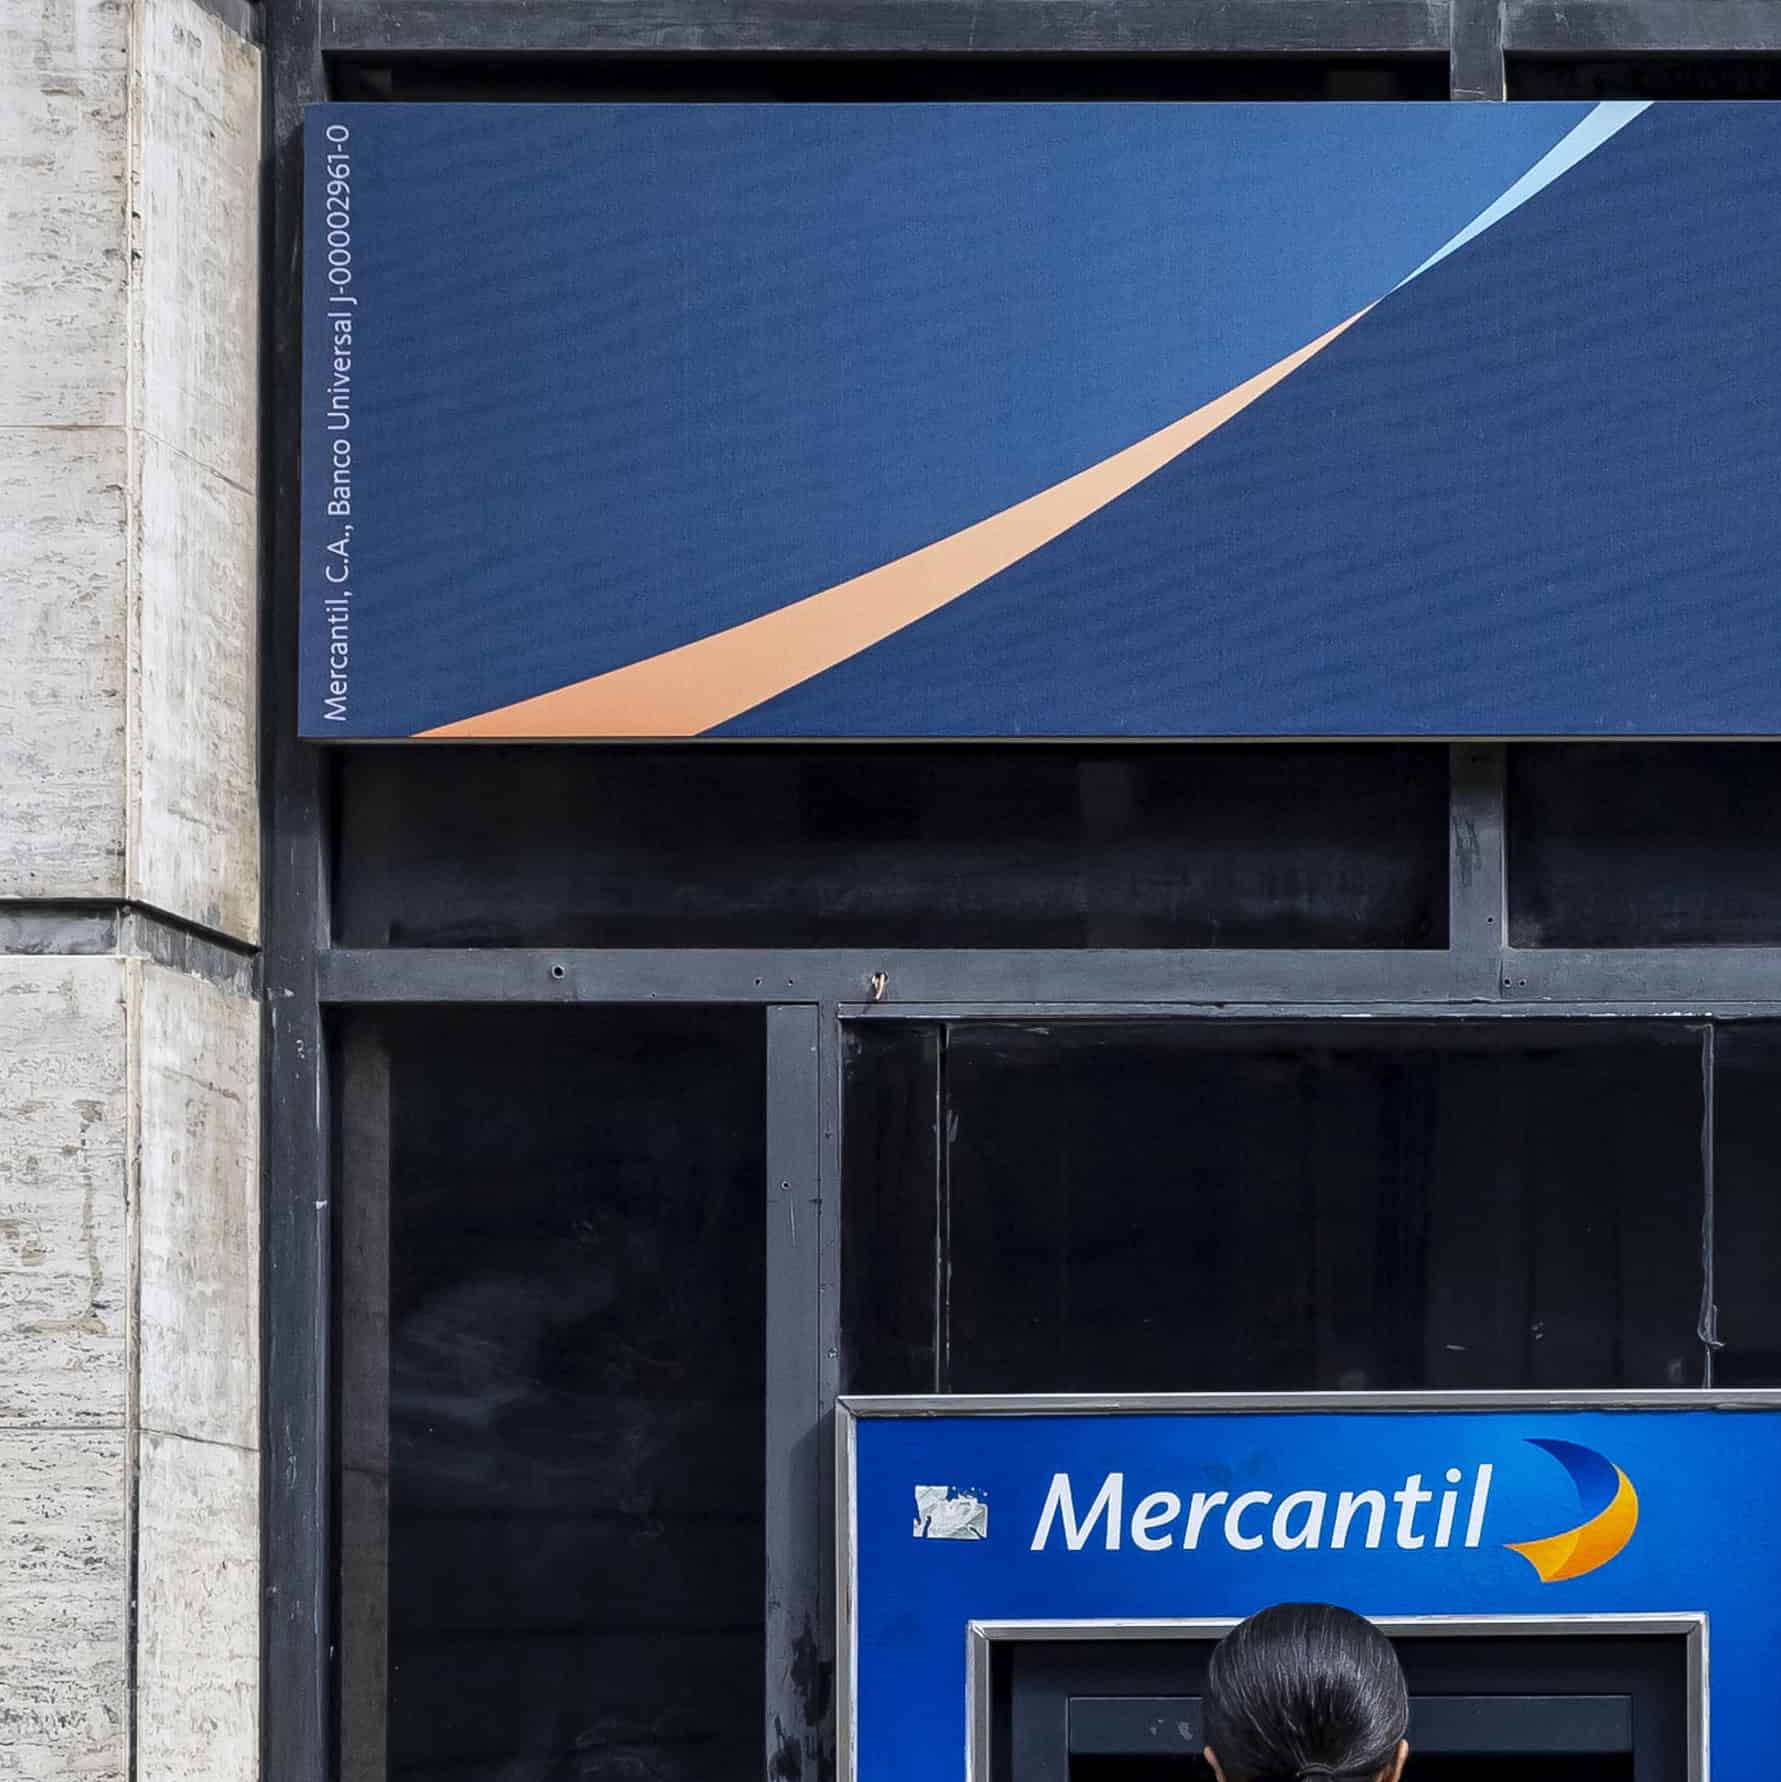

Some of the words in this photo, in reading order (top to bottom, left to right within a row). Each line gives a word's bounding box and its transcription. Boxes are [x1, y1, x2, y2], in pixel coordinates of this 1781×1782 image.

[325, 124, 358, 305] J-00002961-0
[327, 312, 352, 430] Universal
[327, 439, 351, 513] Banco
[325, 524, 354, 583] C.A.,
[323, 591, 353, 721] Mercantil,
[1030, 1463, 1493, 1552] Mercantil
